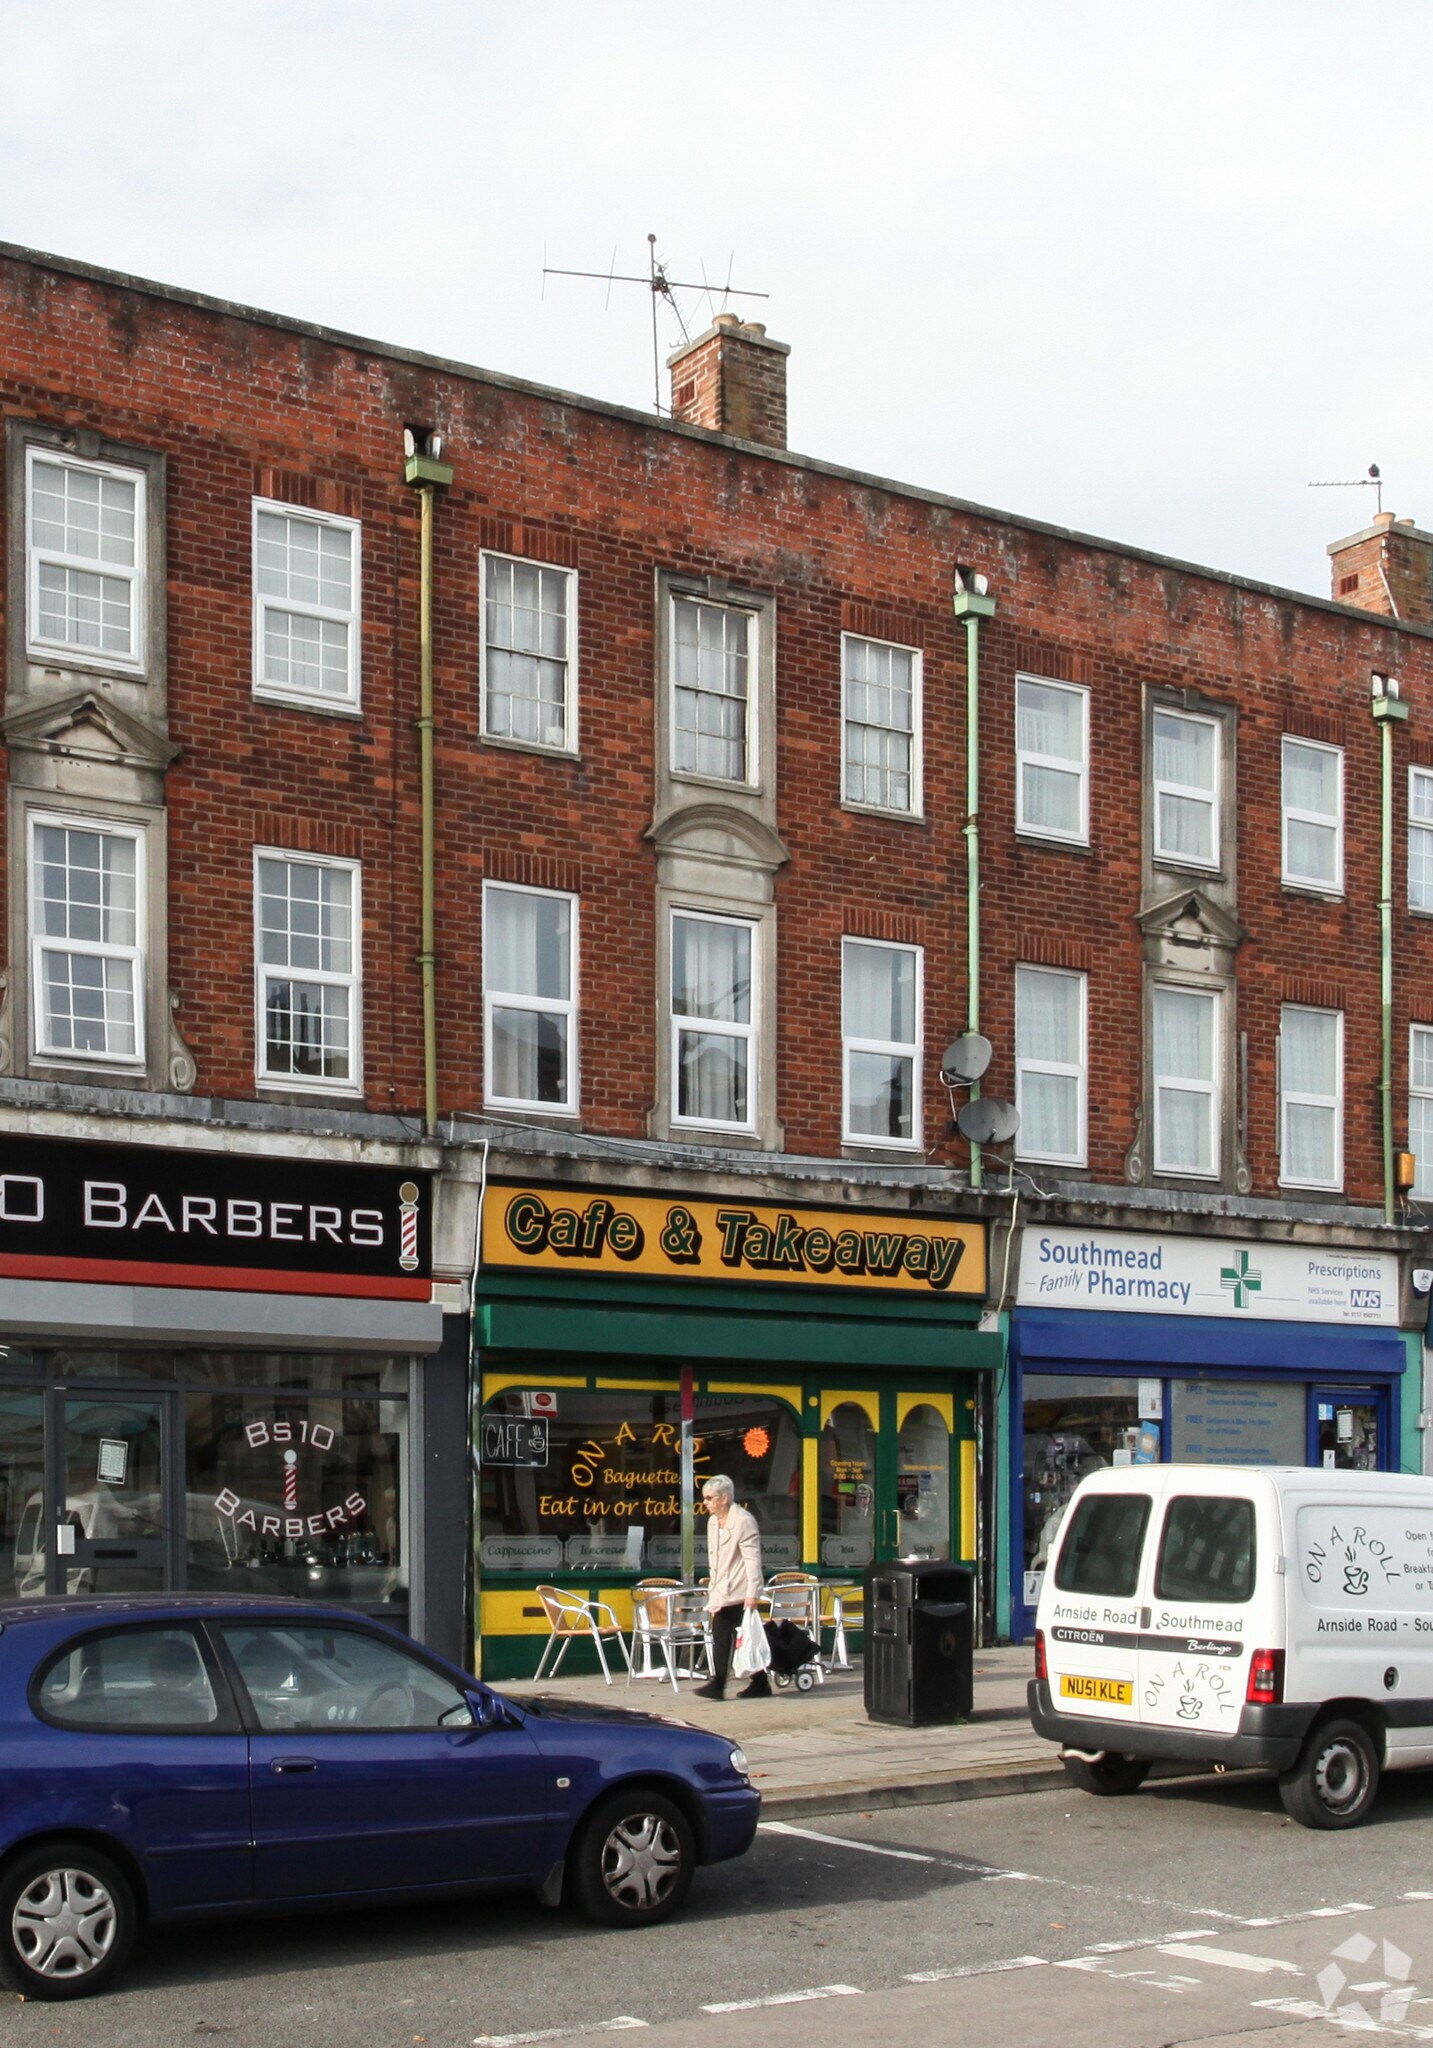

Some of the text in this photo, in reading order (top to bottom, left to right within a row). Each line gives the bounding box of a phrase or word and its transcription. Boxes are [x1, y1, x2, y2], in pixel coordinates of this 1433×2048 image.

[84, 1180, 384, 1246] BARBERS
[504, 1193, 966, 1290] Cafe & Takeaway
[1039, 1238, 1162, 1270] Southmead
[1308, 1262, 1381, 1280] Prescriptions
[1040, 1269, 1191, 1306] Family Pharmacy
[1351, 1290, 1380, 1308] NHS
[486, 1424, 525, 1458] CAFE
[571, 1440, 606, 1487] ON
[614, 1421, 637, 1446] A
[603, 1469, 682, 1489] Baguette
[214, 1487, 366, 1537] BARBERS
[540, 1496, 578, 1515] Eat
[584, 1497, 610, 1516] in
[614, 1500, 639, 1516] or
[1405, 1530, 1427, 1543] Open
[487, 1545, 552, 1559] Cappuccino
[1306, 1525, 1401, 1585] ON A ROLL
[1053, 1604, 1243, 1632] Arnside Road Southmead
[1317, 1618, 1362, 1631] Arnside
[1368, 1618, 1397, 1631] Road
[1056, 1629, 1104, 1643] CITROËN
[1186, 1639, 1232, 1655] Berlingo
[1100, 1681, 1125, 1701] KLE
[1145, 1661, 1236, 1714] ON A ROLL
